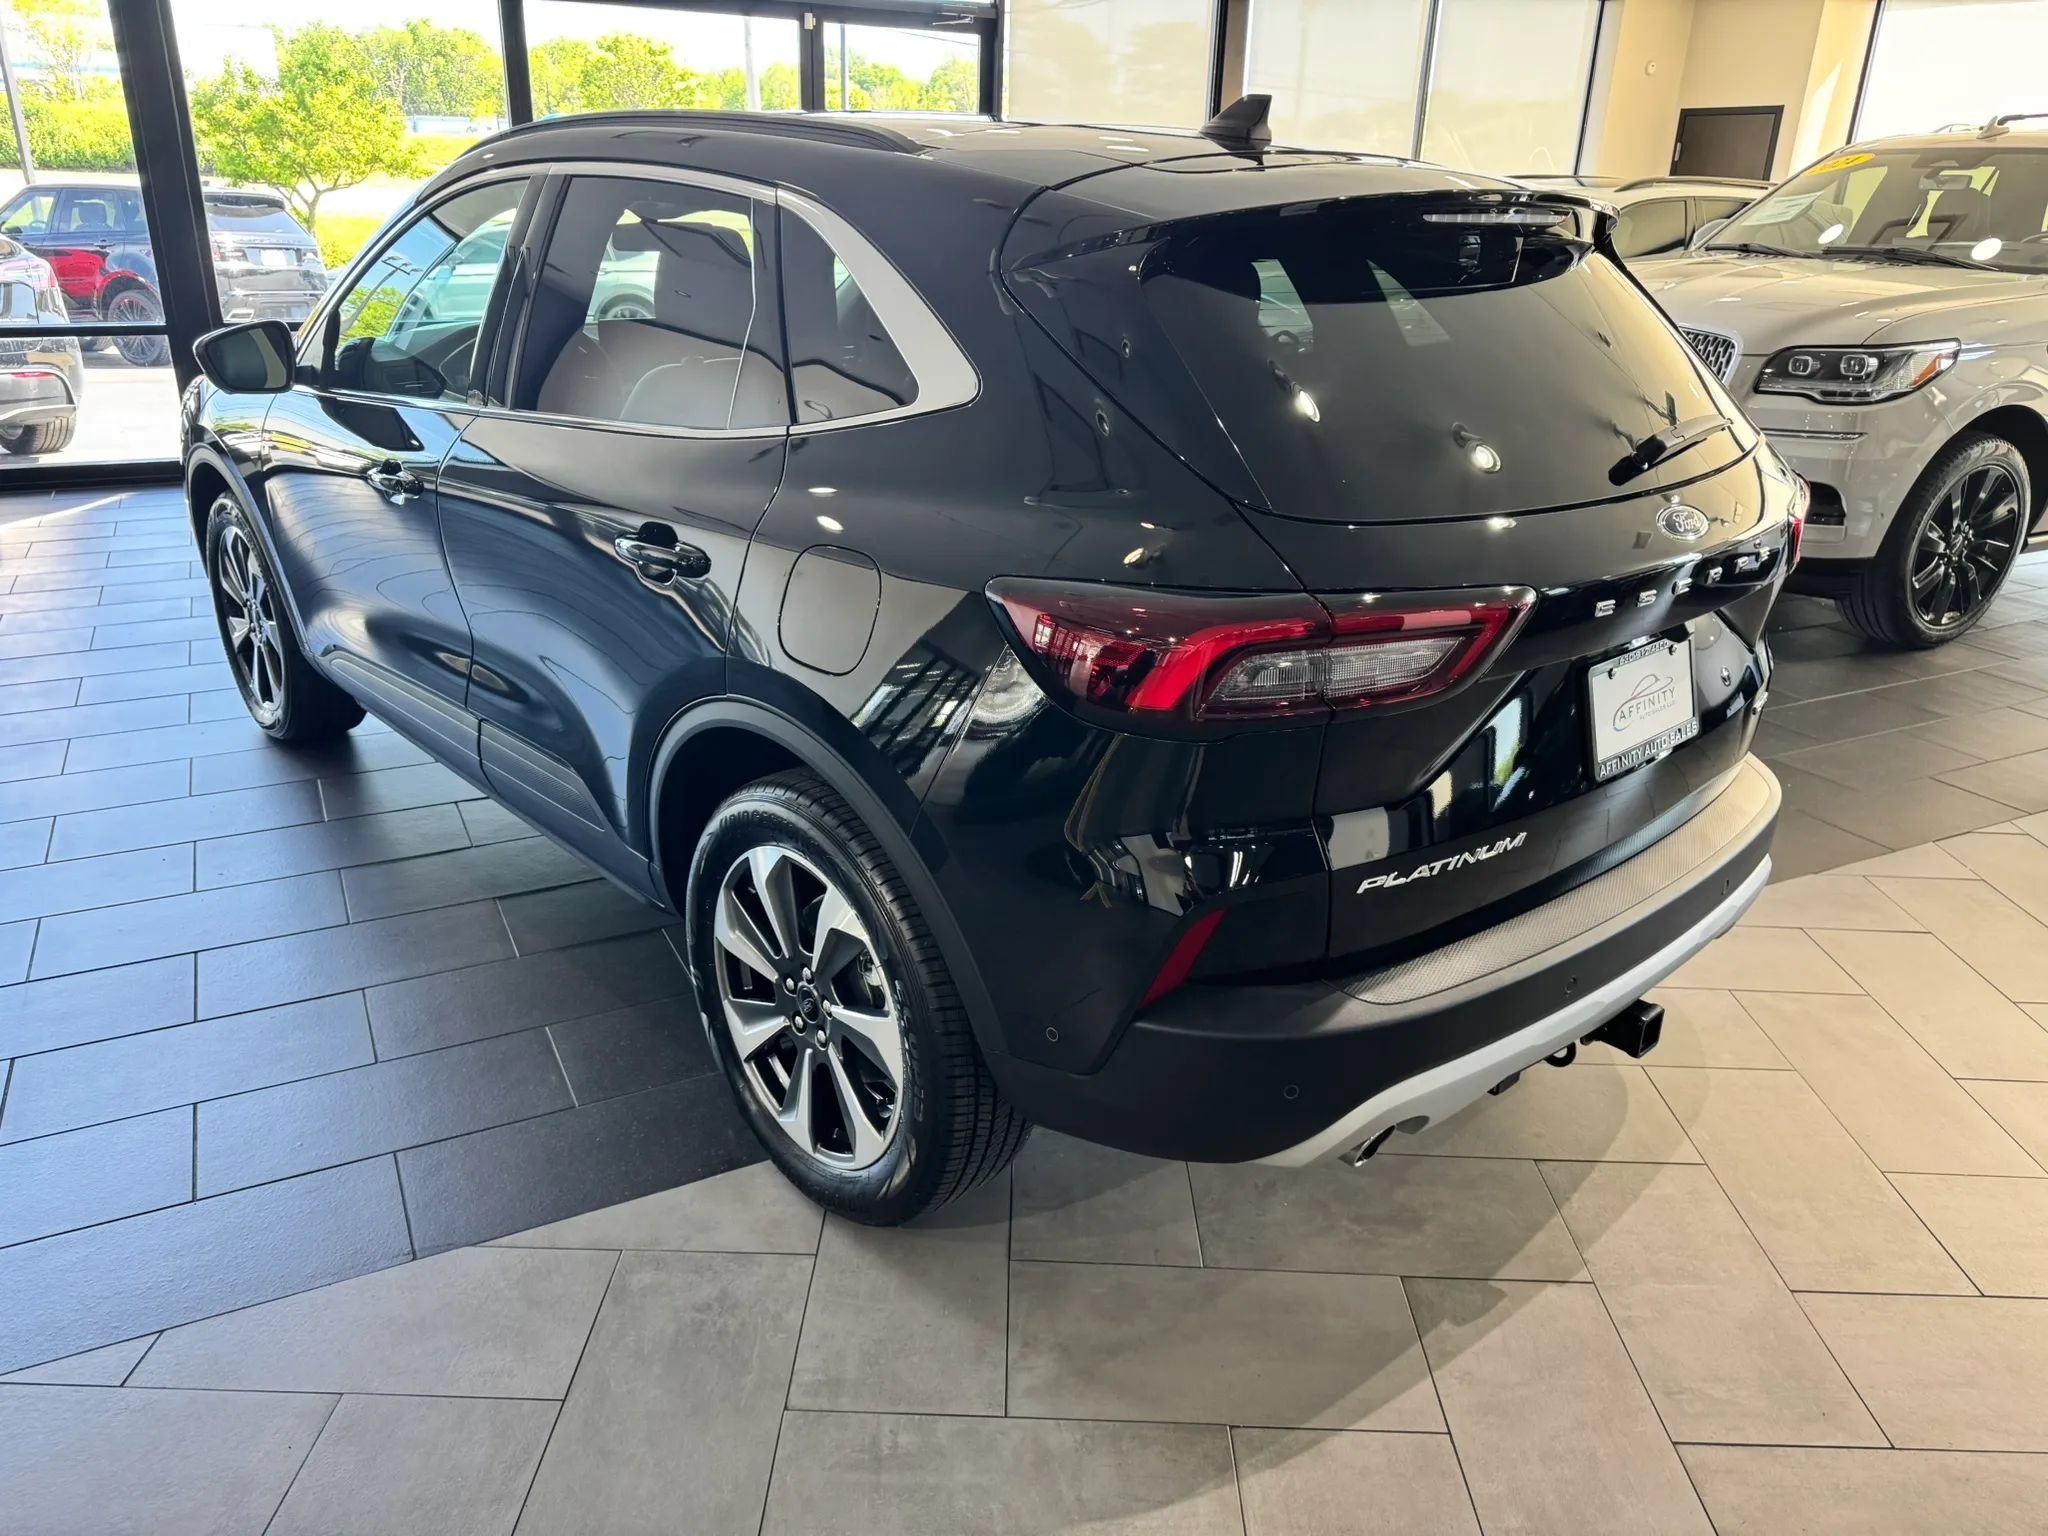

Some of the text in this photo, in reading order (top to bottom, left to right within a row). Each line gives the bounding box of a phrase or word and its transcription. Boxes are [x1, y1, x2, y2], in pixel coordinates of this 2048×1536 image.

[1673, 511, 1701, 532] Ford
[1619, 687, 1675, 722] AFFINITY
[1600, 720, 1697, 778] AFFINITY AUTO SALES
[1356, 832, 1527, 894] PLATINUM
